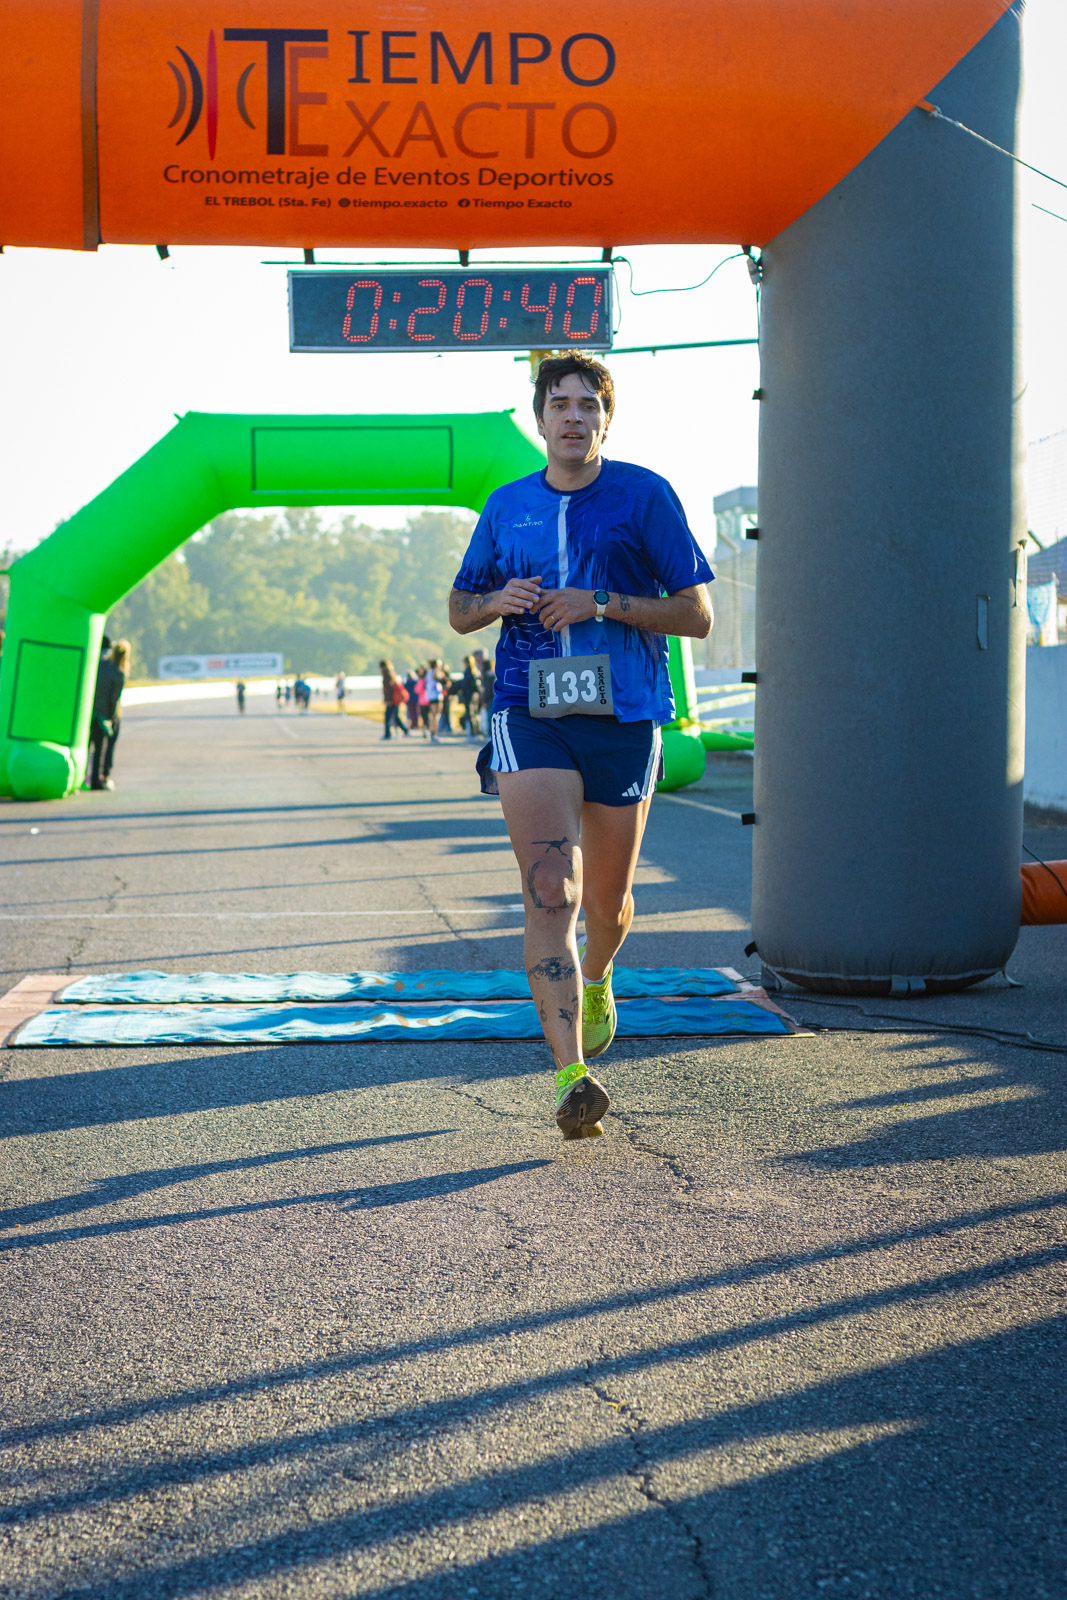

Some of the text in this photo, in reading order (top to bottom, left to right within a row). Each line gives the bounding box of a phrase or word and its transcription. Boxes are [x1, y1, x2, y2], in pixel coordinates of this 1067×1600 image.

[163, 164, 614, 190] Cronometraje de Eventos Deportivos
[205, 196, 220, 206] EL
[222, 196, 275, 207] TREBOL
[278, 197, 308, 208] (Sta.
[311, 197, 331, 208] Fe)
[472, 199, 524, 210] Tiempo
[527, 199, 573, 209] Exacto
[342, 276, 602, 342] 0:20:40
[537, 670, 547, 709] TIEMPO
[545, 669, 598, 705] 133
[597, 666, 607, 705] EXACTO
